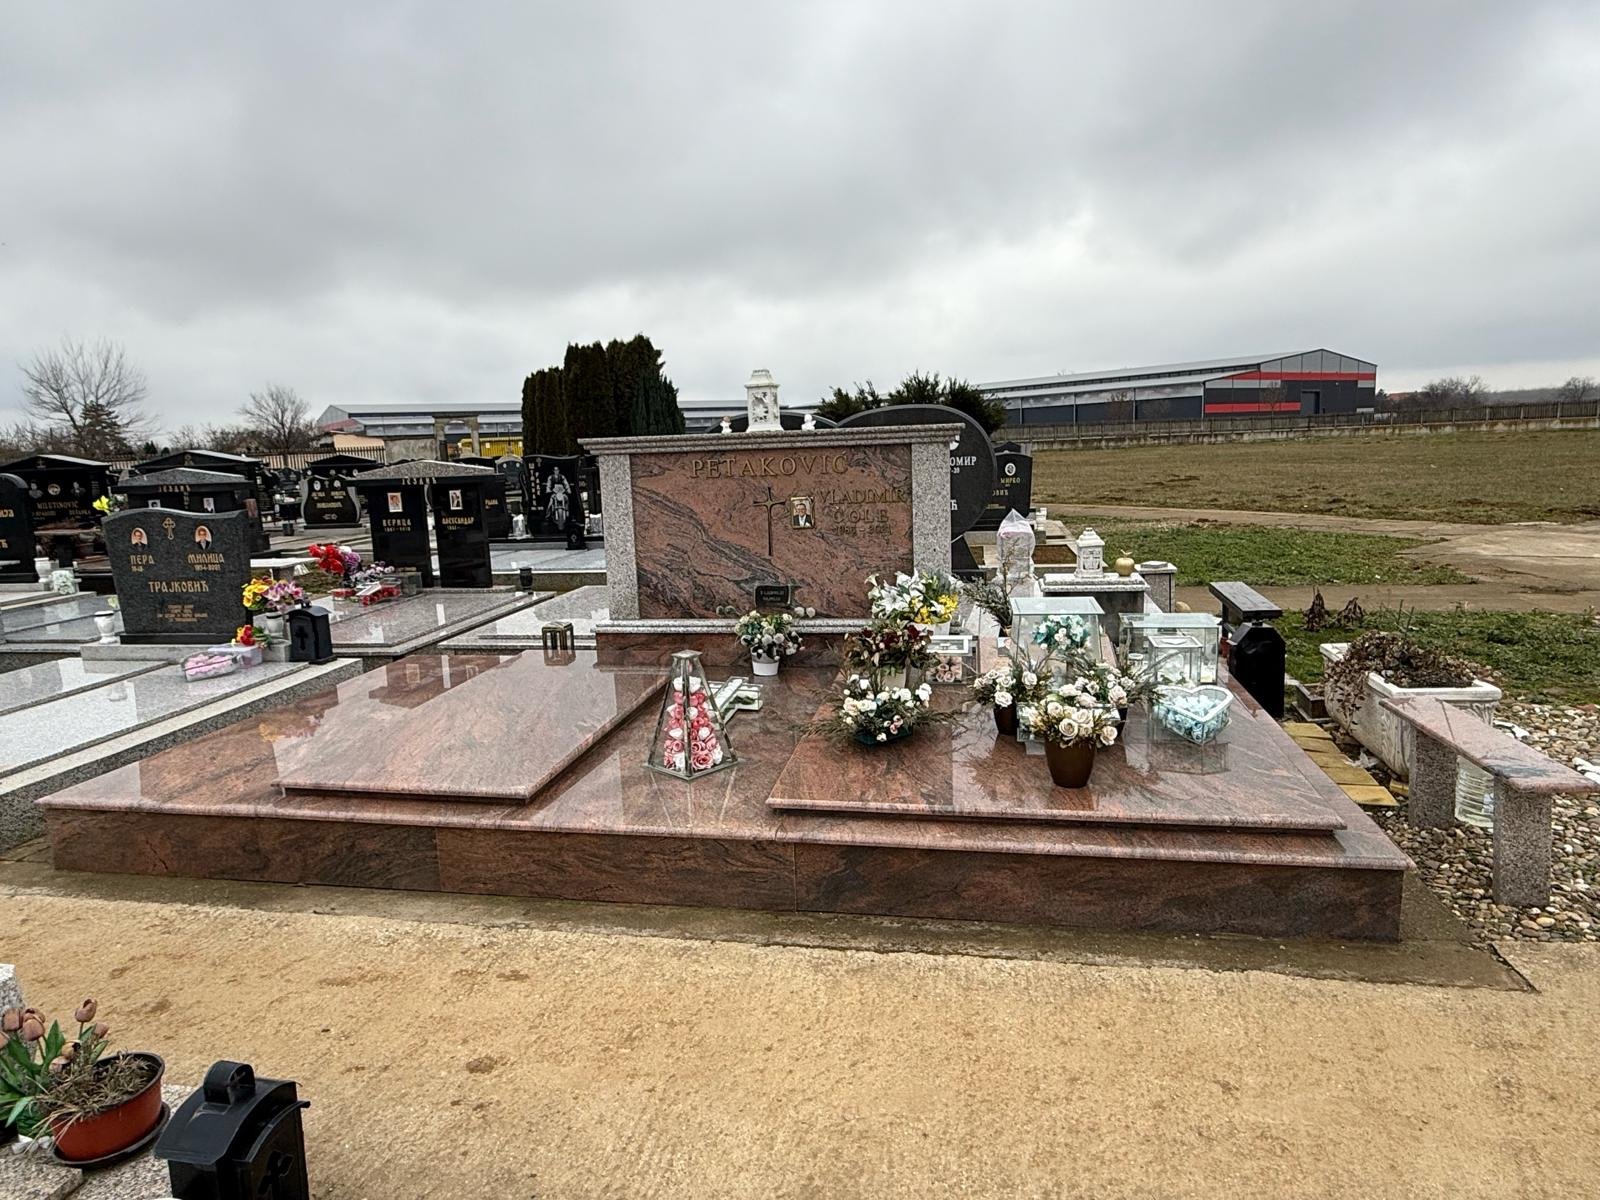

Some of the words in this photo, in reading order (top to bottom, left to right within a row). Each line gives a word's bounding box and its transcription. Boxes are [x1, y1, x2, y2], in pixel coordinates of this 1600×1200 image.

[691, 451, 850, 479] PETAKOVIĆ
[818, 488, 906, 505] VLADIMIR
[129, 554, 156, 565] ПЕРА
[187, 553, 225, 564] МИЛИЦА
[147, 580, 209, 593] ТРАЈКОВИЋ
